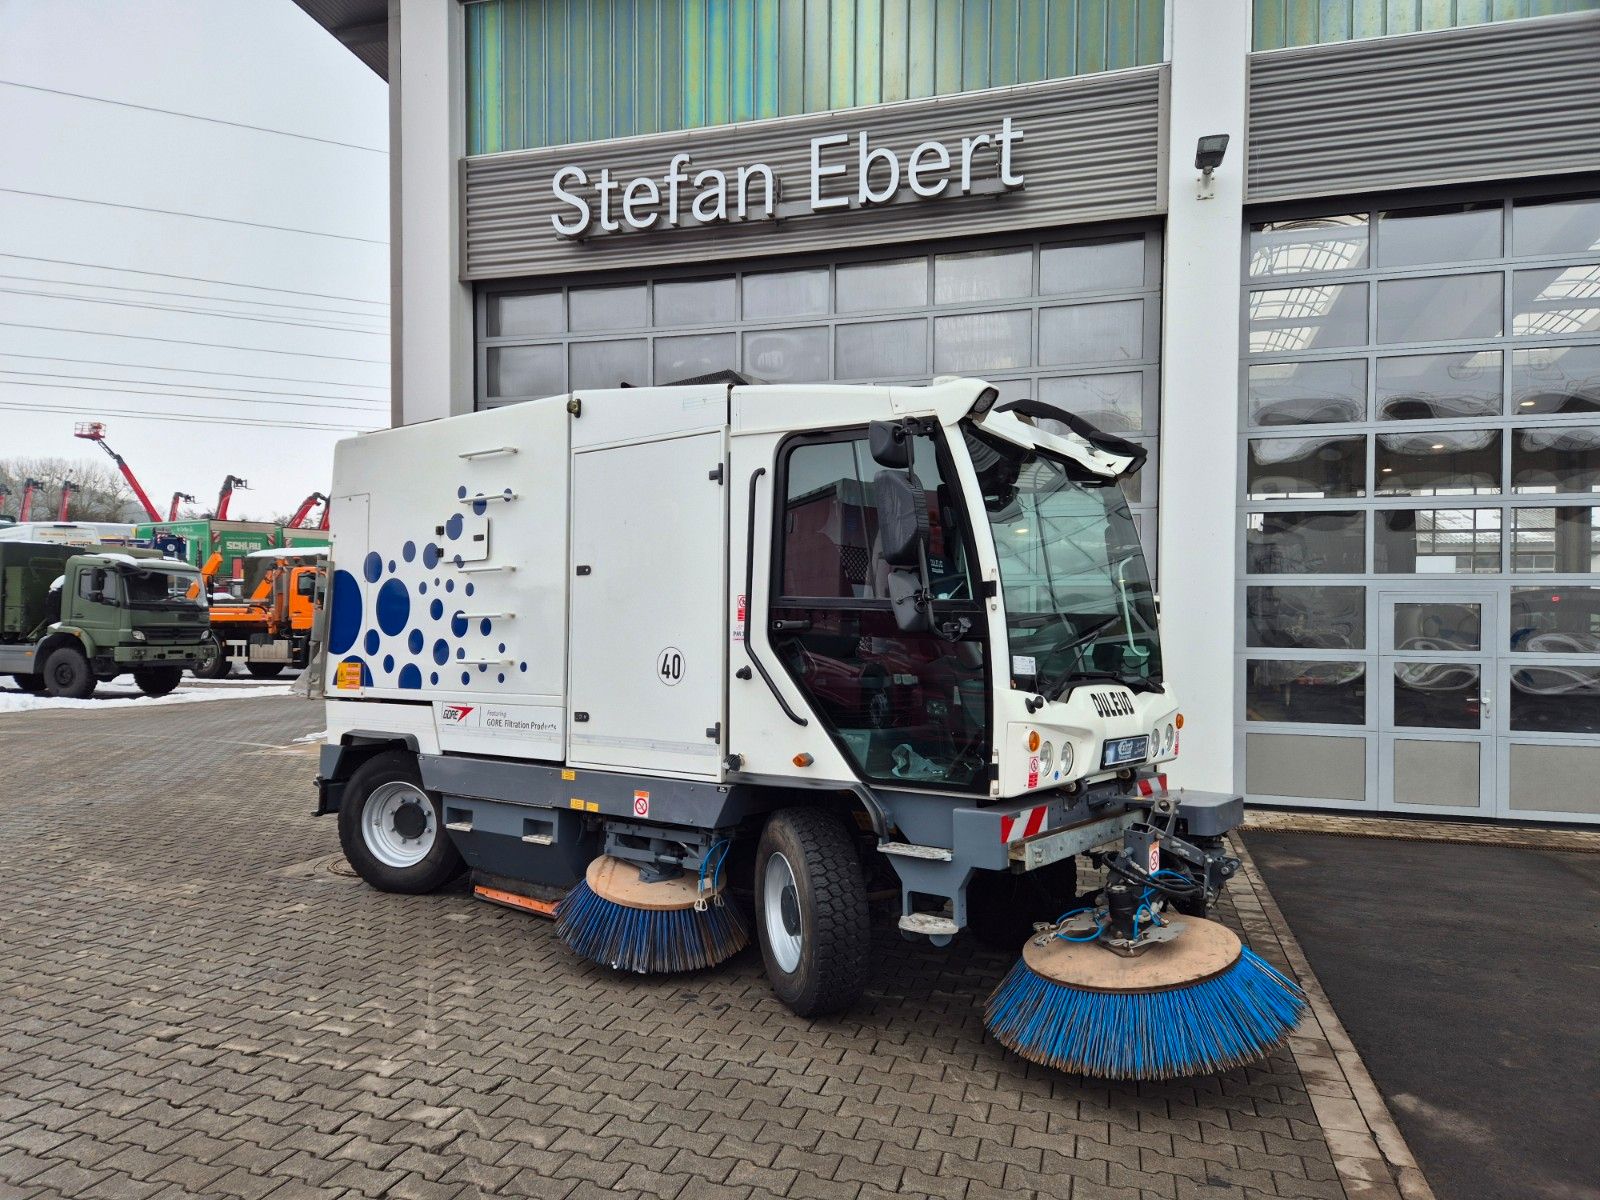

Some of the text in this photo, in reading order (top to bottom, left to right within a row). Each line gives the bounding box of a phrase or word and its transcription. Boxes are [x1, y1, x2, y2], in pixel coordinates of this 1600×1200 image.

[550, 117, 1025, 236] Stefan Ebert
[661, 653, 681, 680] 40
[487, 709, 507, 718] Featuring
[1090, 691, 1135, 718] DULEVO
[442, 709, 459, 720] GORE
[486, 718, 503, 728] GORE
[504, 719, 530, 729] Filtration
